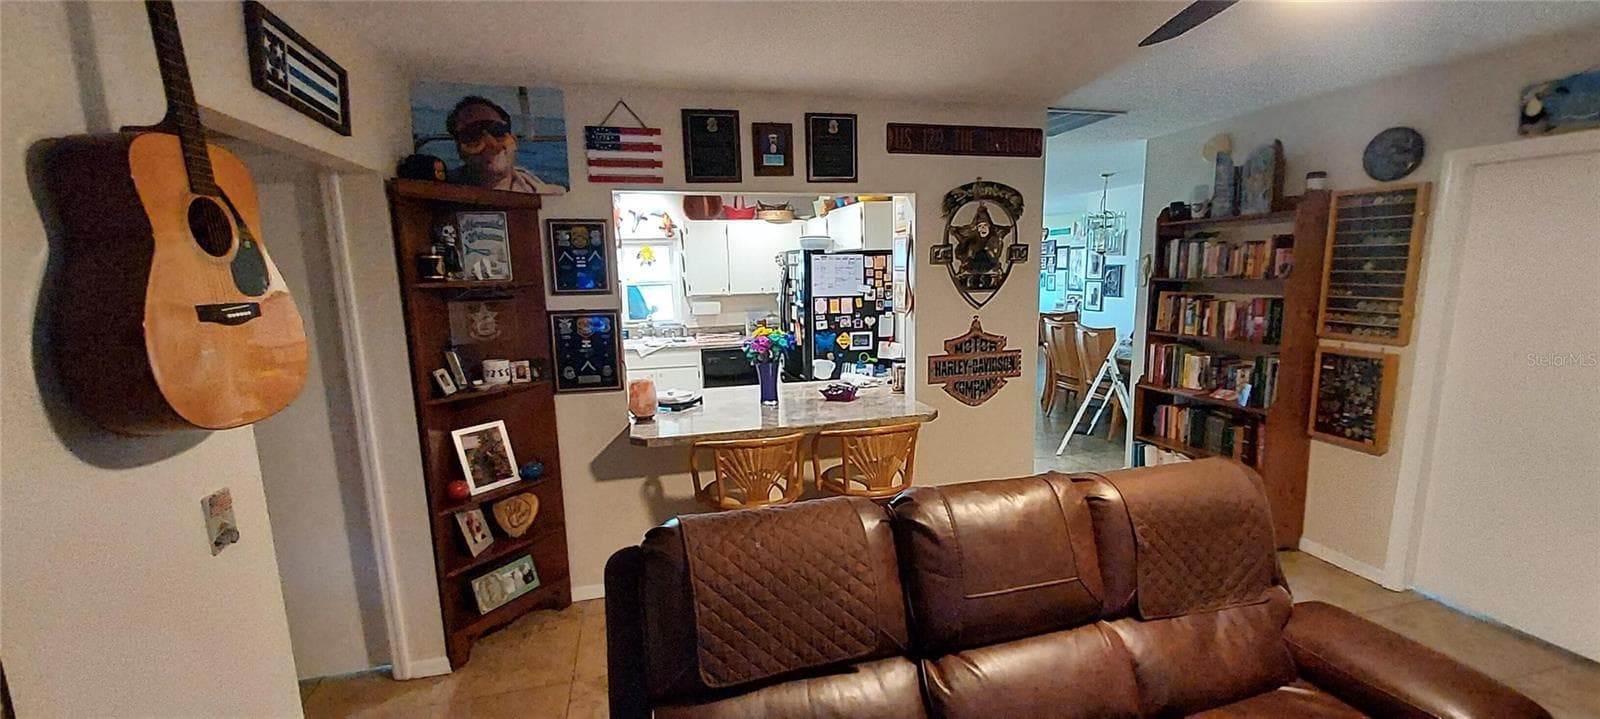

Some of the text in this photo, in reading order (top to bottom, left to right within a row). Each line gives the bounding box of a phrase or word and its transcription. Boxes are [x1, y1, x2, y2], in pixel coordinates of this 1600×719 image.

[953, 129, 978, 152] THE
[954, 337, 997, 353] MOTOR
[935, 354, 1016, 377] HARLEY-DAVIDSON
[954, 377, 998, 399] COMPANY
